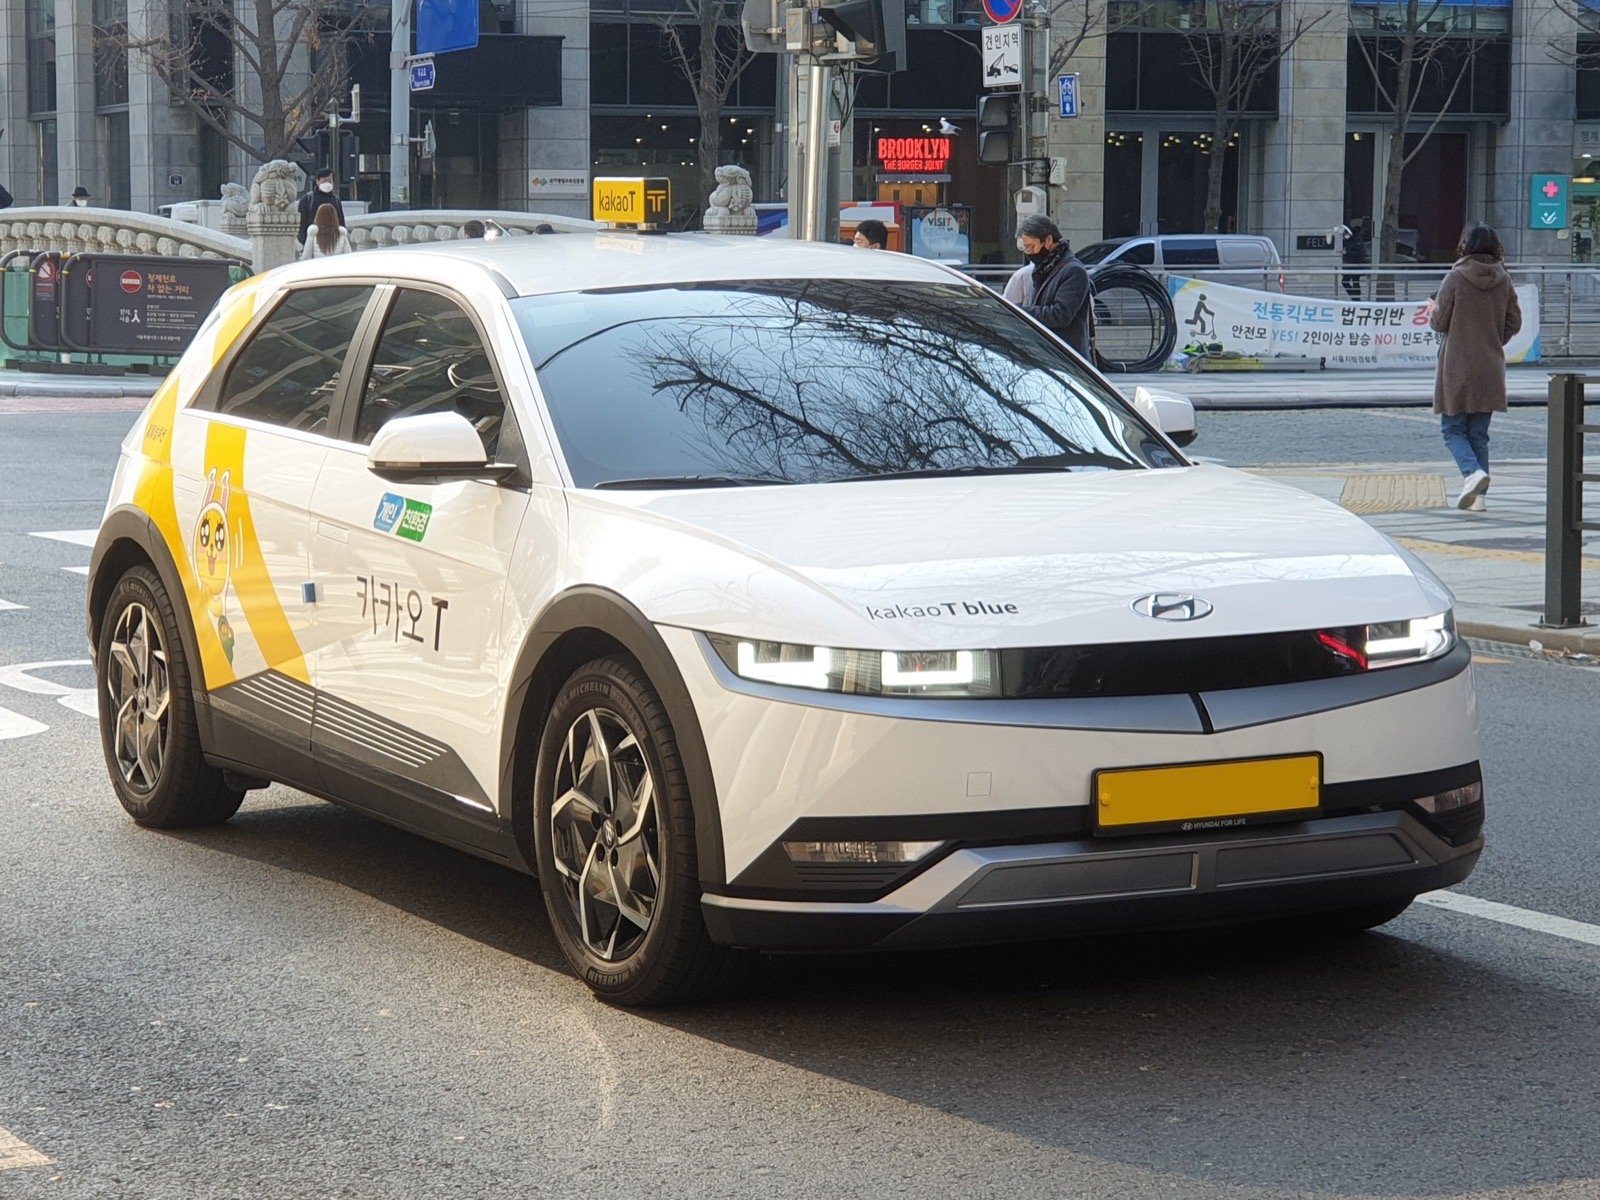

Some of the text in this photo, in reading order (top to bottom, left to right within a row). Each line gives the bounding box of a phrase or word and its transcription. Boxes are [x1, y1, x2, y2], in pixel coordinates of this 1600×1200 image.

[985, 32, 1019, 50] 견인지역
[878, 138, 950, 159] BROOKLYN
[883, 160, 945, 171] THE BURGER JOINT
[928, 217, 951, 226] VISIT
[1253, 302, 1334, 324] 전동킥보드
[1341, 306, 1405, 327] 법규위반
[1231, 325, 1267, 340] 안전모
[1272, 329, 1298, 341] YES!
[1302, 331, 1345, 345] 2인이상
[1349, 332, 1371, 346] 탑승
[1375, 334, 1397, 345] NO!
[377, 502, 398, 523] 개인
[402, 509, 429, 532] 친환경
[961, 600, 1019, 615] blue
[569, 681, 611, 698] MICHELIN
[1194, 821, 1220, 829] HYUNDAI
